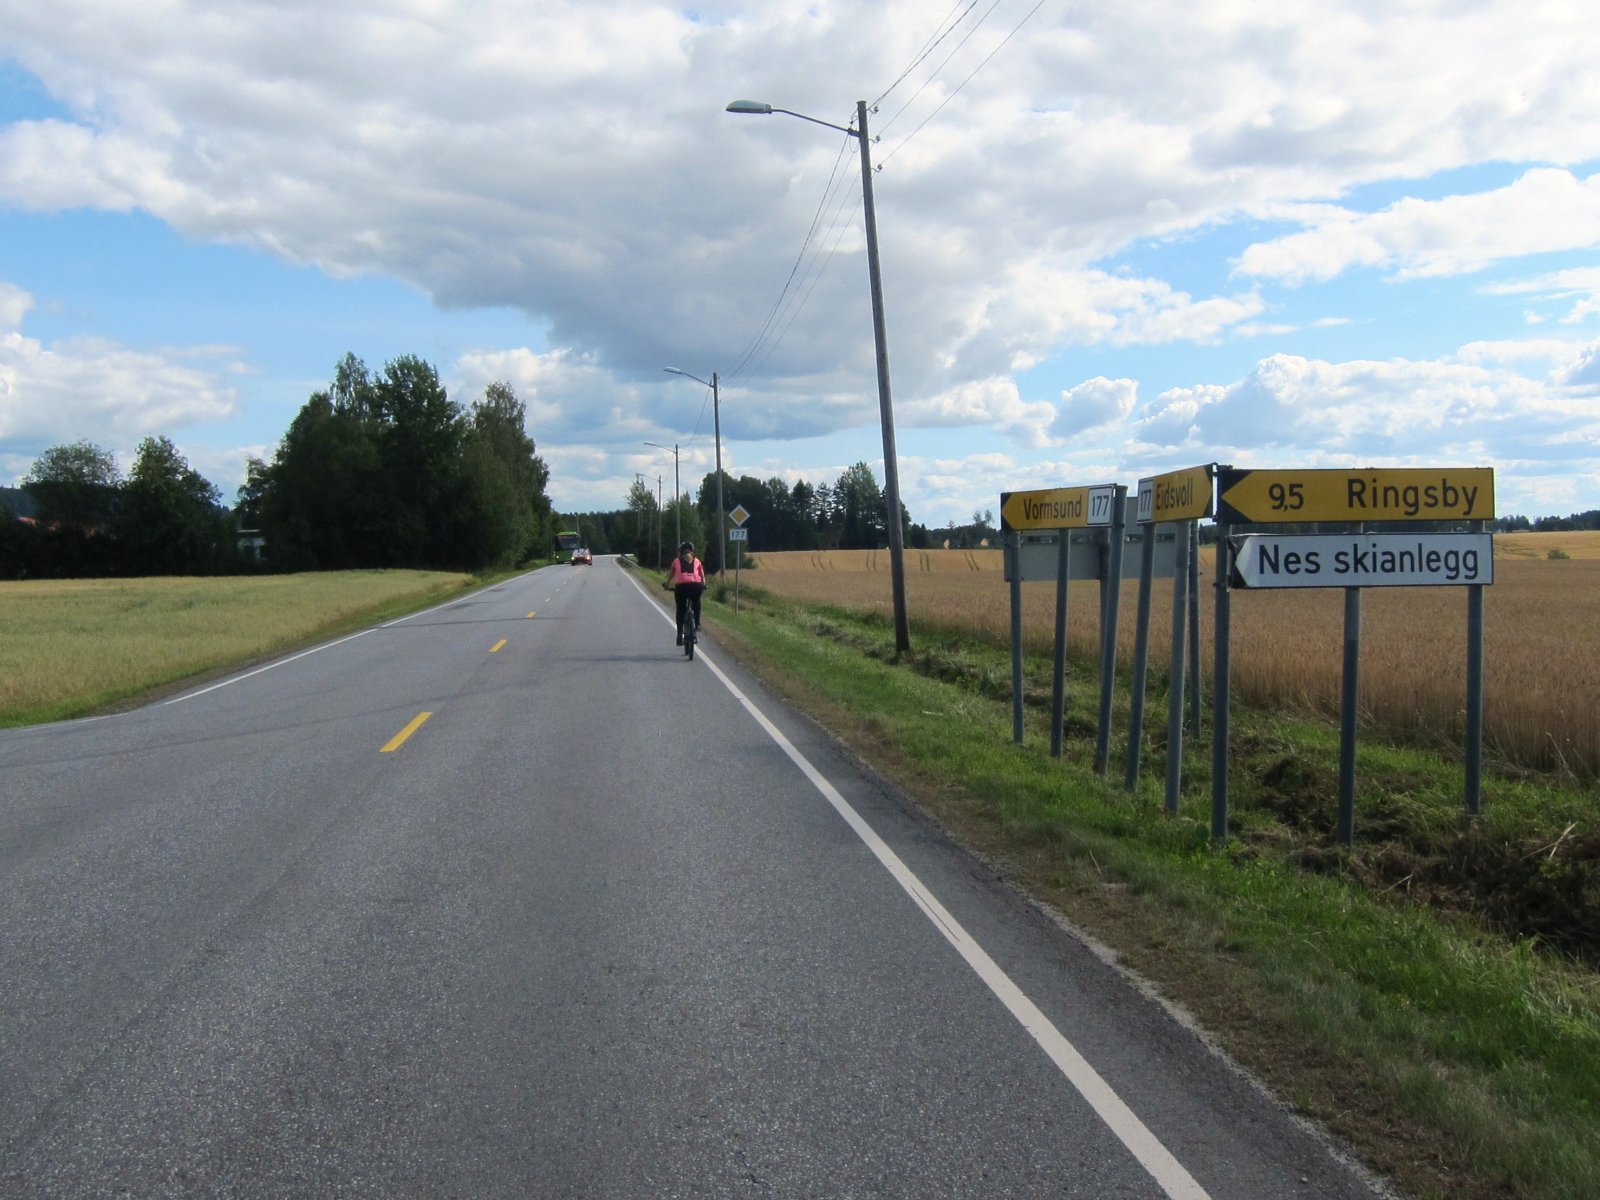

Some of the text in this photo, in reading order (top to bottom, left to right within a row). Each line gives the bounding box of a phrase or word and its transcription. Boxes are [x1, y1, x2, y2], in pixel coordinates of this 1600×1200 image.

[1023, 494, 1082, 520] Vormsund
[1091, 495, 1110, 517] 177
[1140, 489, 1152, 513] 177
[1156, 478, 1193, 510] Eidsvoll
[1268, 478, 1478, 516] 9,5 Ringsby
[1258, 543, 1478, 580] Nes skianlegg
